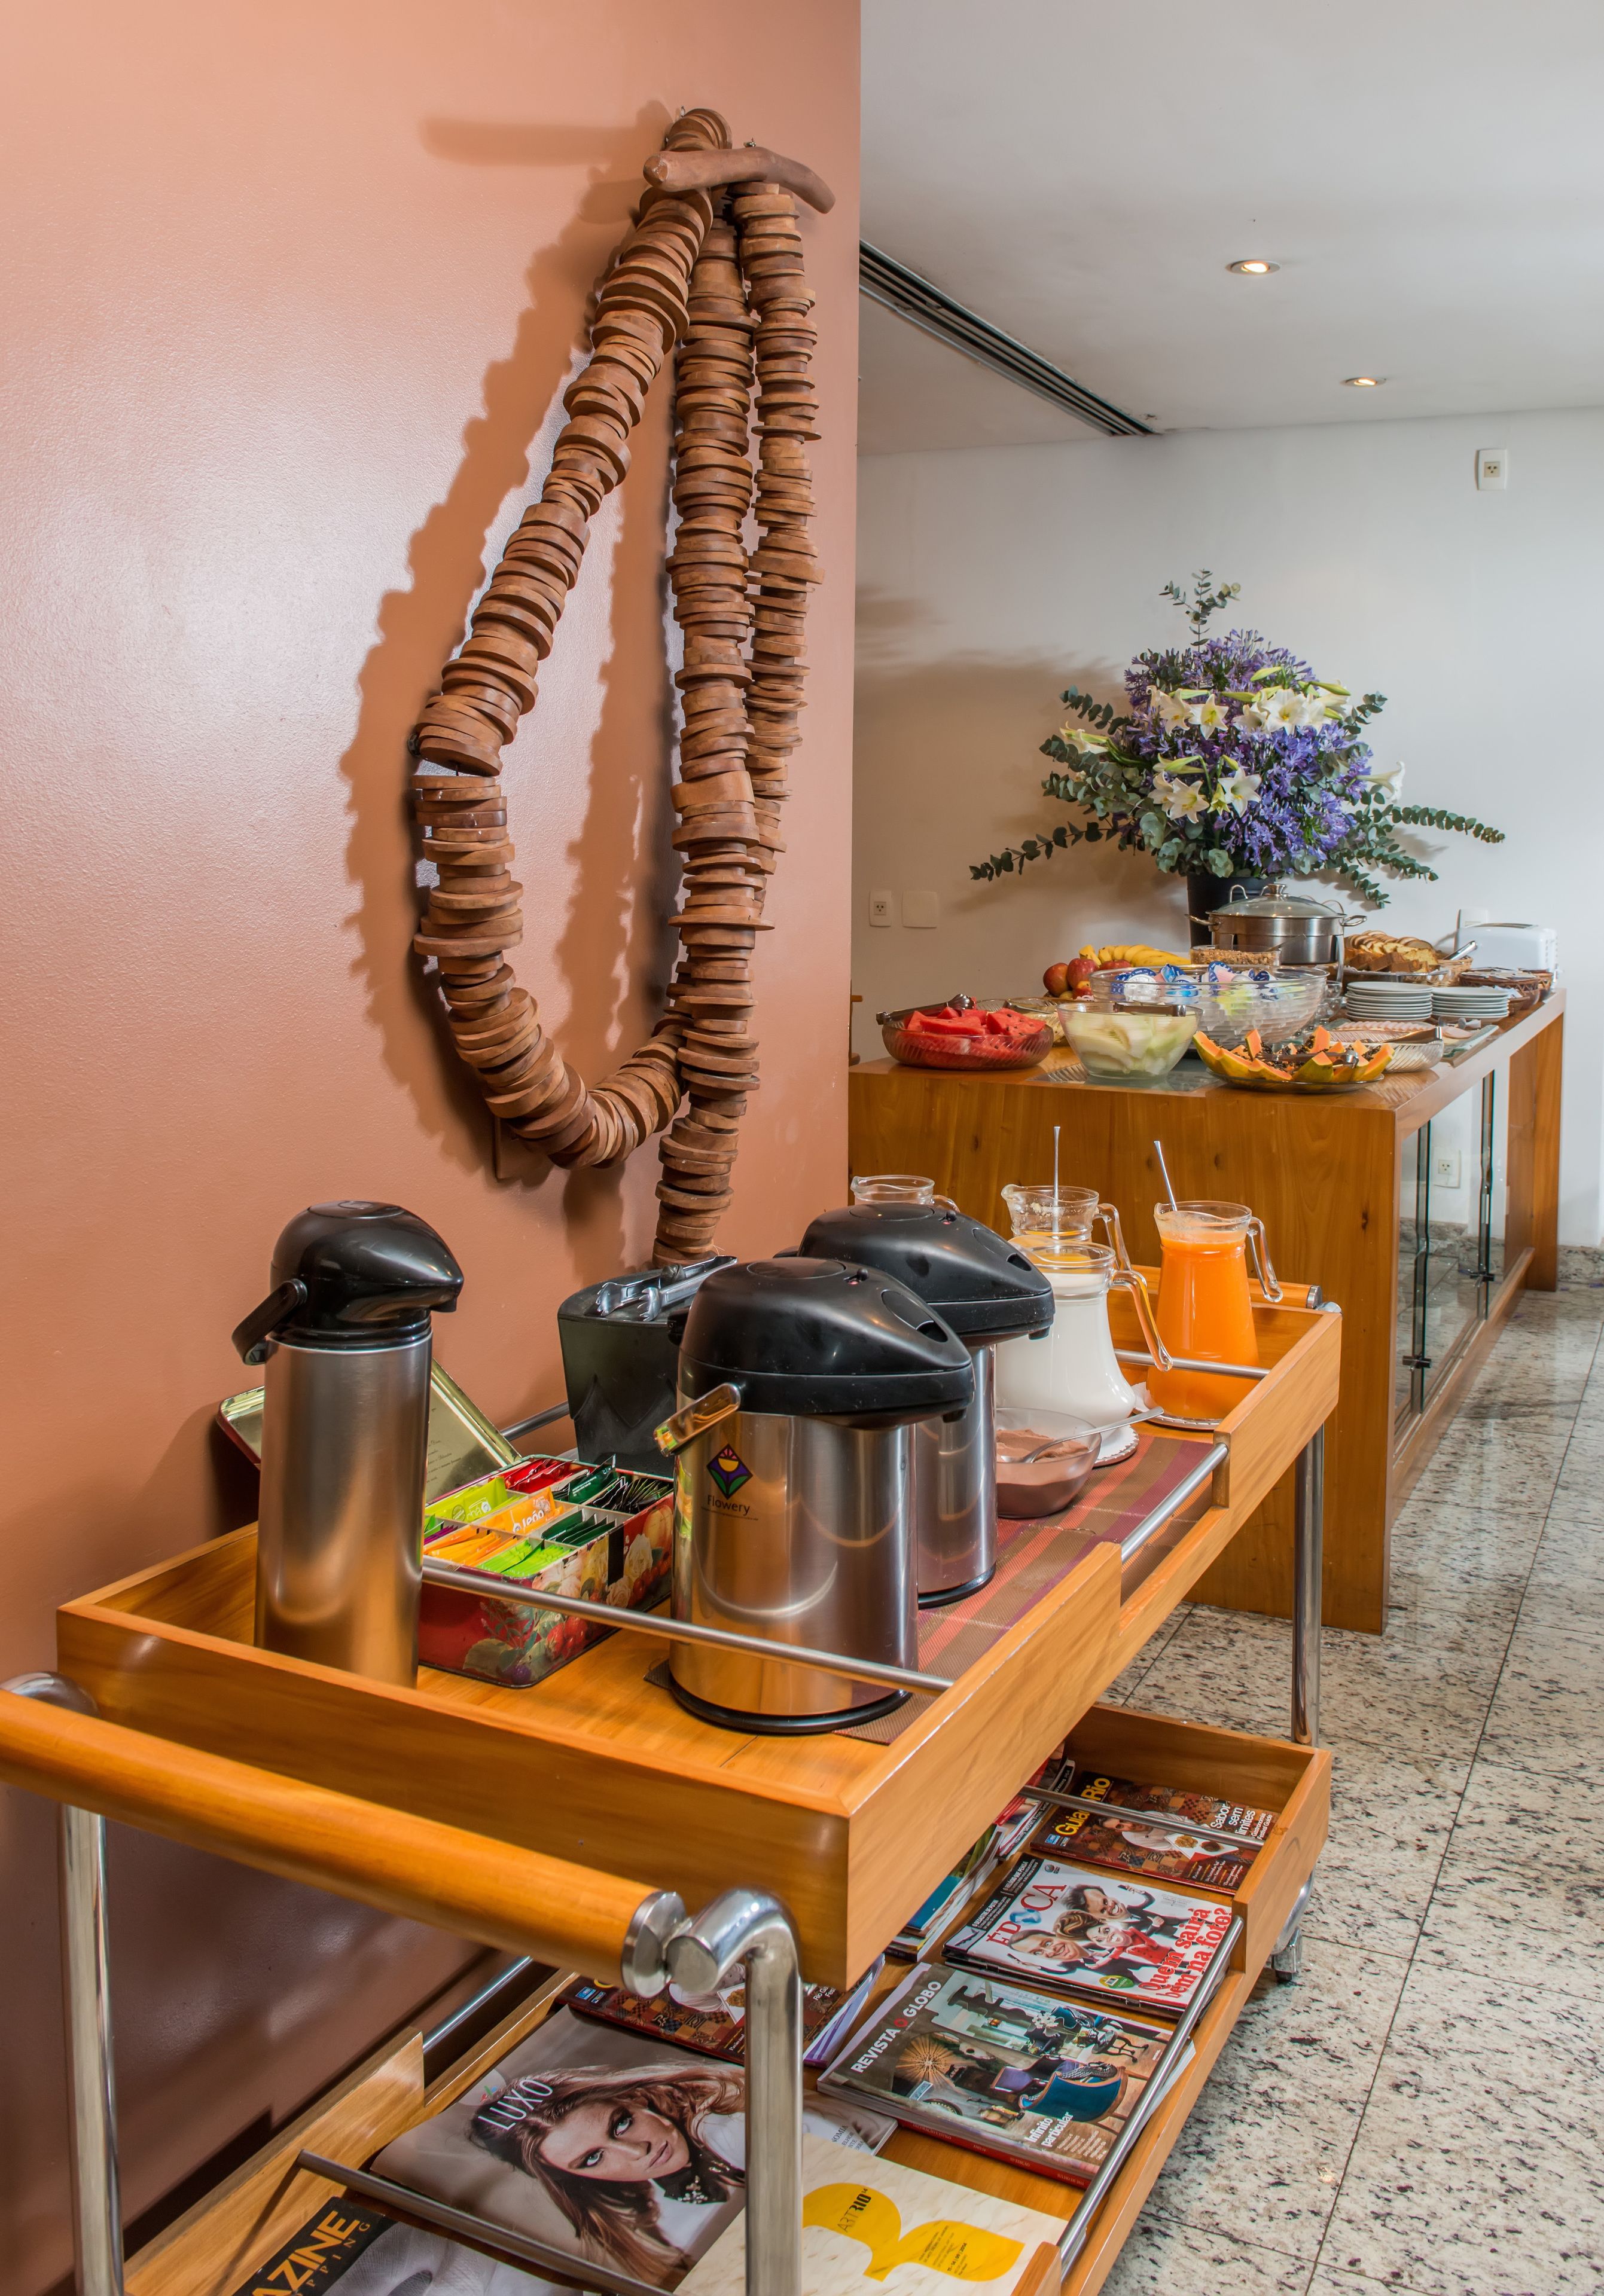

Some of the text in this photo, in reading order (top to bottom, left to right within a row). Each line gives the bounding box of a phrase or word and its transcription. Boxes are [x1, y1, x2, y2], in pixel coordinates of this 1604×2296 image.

[708, 1495, 750, 1516] Flowery
[522, 1510, 544, 1528] leão
[1081, 1778, 1111, 1801] Rio
[1210, 1803, 1230, 1828] Sabor
[1228, 1807, 1243, 1826] sem
[1234, 1810, 1255, 1836] limites
[1251, 1813, 1266, 1837] Gastronomia
[1257, 1814, 1273, 1840] Festival Guide
[1197, 1907, 1232, 1949] foto?
[1138, 1951, 1186, 1990] Quem
[1175, 1907, 1211, 1949] sairá
[1186, 1950, 1212, 1974] na
[1155, 1973, 1199, 1999] bem
[850, 1981, 941, 2073] REVISTA O GLOBO
[478, 2080, 553, 2130] LUXO
[1024, 2117, 1053, 2143] Infinito
[1041, 2111, 1074, 2148] particular
